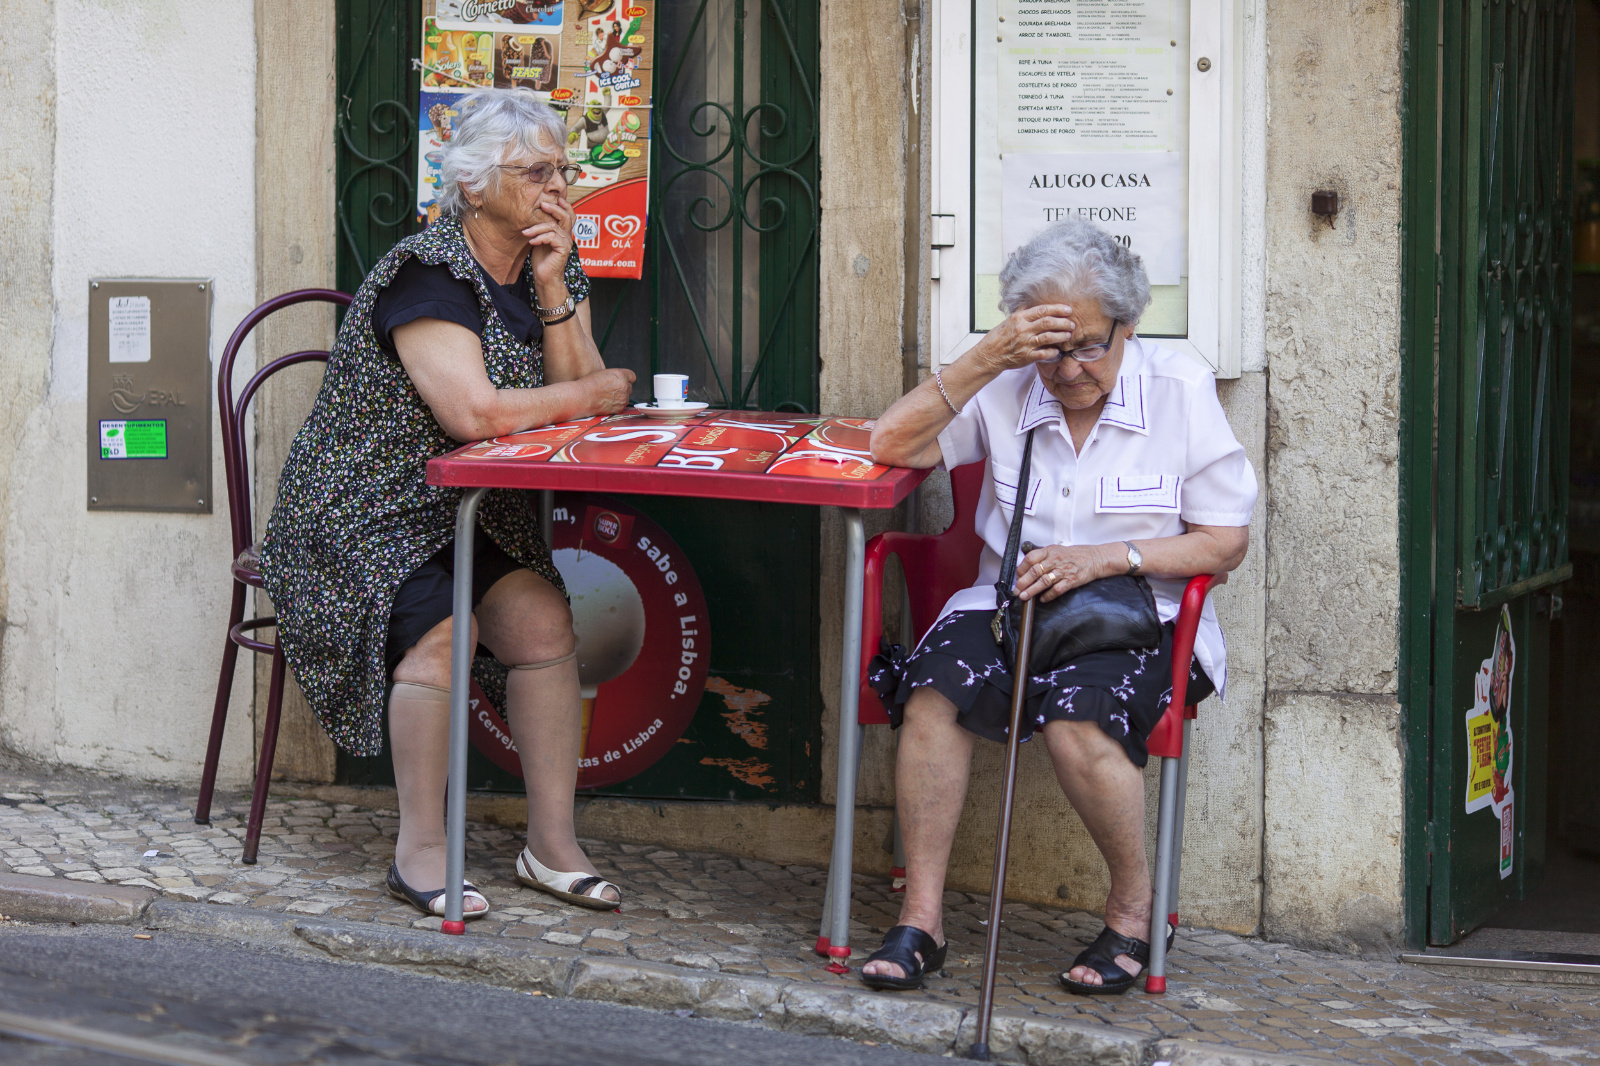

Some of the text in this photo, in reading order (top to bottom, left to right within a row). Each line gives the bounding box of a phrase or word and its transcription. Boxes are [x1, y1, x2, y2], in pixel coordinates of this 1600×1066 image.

[512, 66, 542, 78] FEAST
[600, 73, 632, 87] ICE COOL
[614, 79, 641, 91] GUITAR
[1029, 173, 1152, 189] ALUGO CASA
[577, 223, 594, 235] Olá
[611, 238, 631, 249] OLÁ
[579, 257, 637, 268] 50anos.com
[149, 390, 186, 406] EPAL
[597, 524, 617, 537] BOCK
[598, 517, 619, 531] SUPER
[552, 507, 699, 701] m, sabe a Lisboa.
[468, 698, 480, 711] A
[577, 756, 601, 769] tas
[603, 750, 622, 764] de
[622, 717, 664, 755] Lisboa
